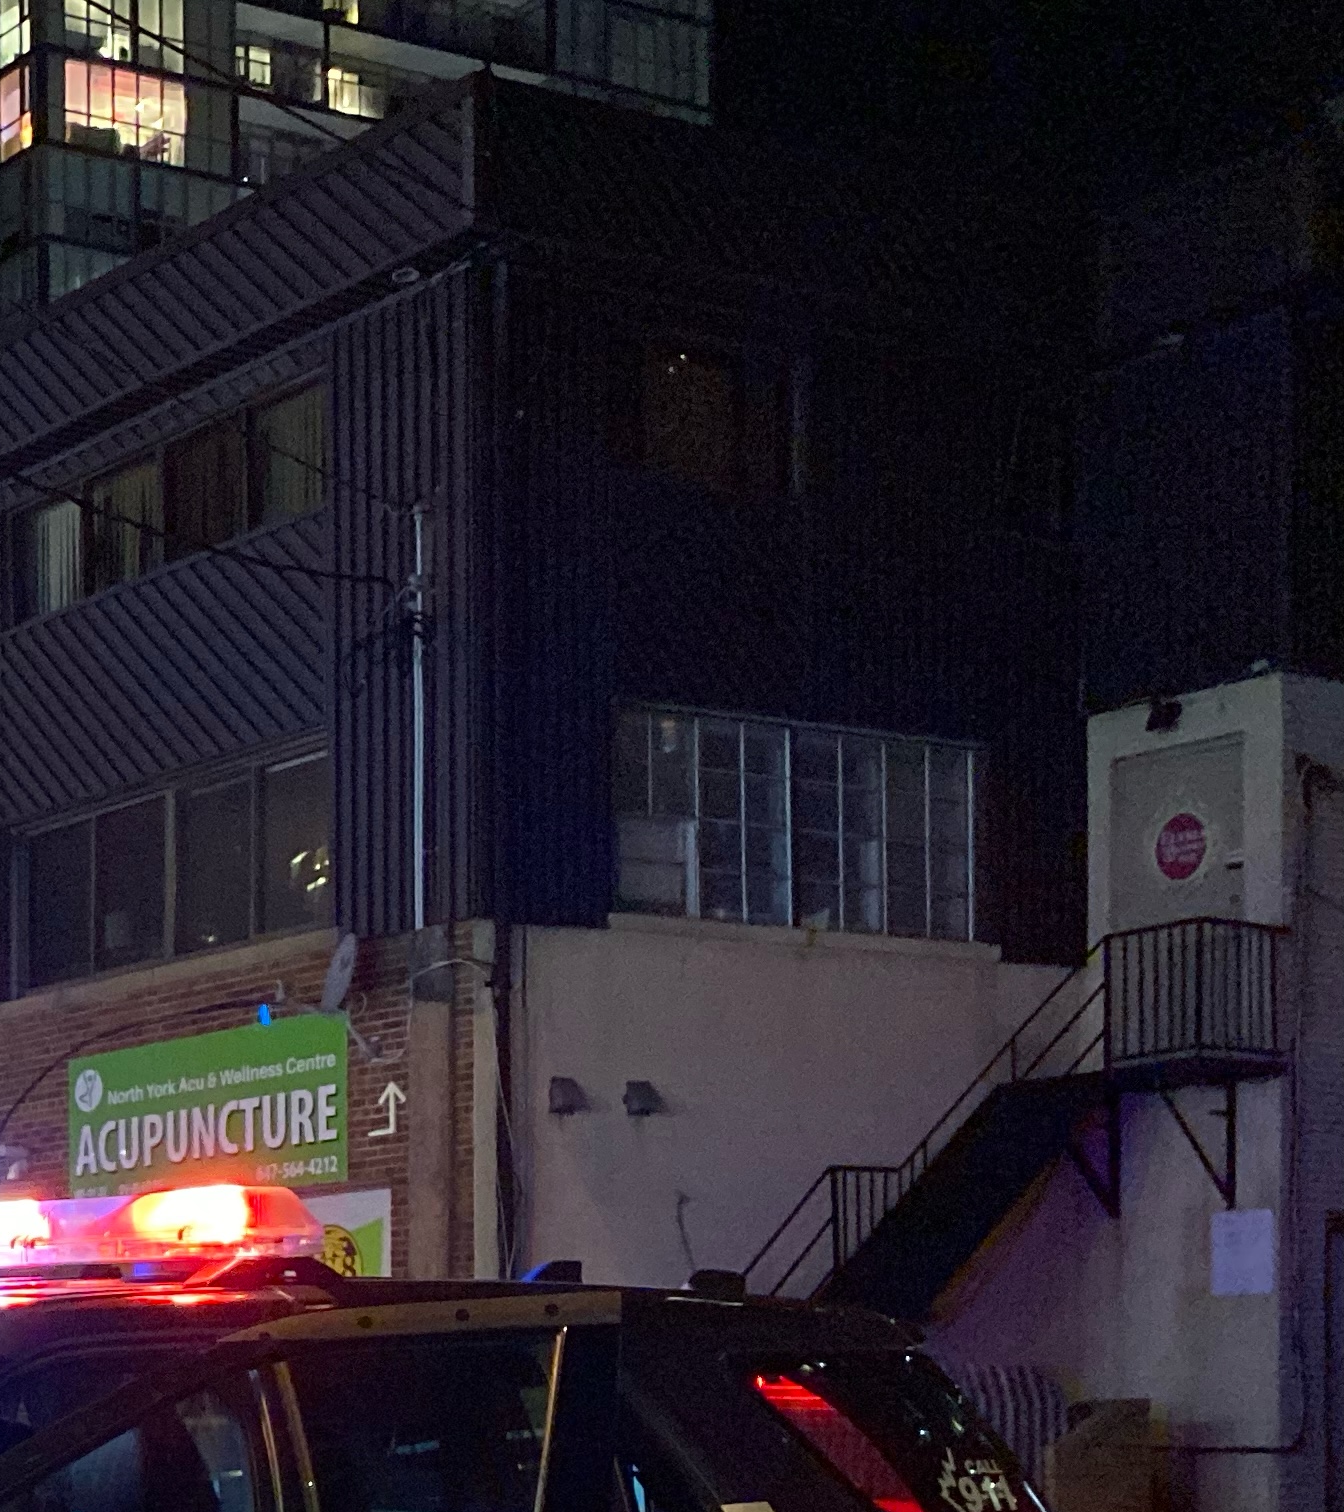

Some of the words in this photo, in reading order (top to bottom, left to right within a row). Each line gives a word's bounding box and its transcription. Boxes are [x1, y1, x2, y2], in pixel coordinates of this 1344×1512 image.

[107, 1084, 143, 1105] North
[146, 1079, 176, 1099] York
[178, 1077, 205, 1093] Acu
[207, 1072, 217, 1088] &
[220, 1063, 282, 1086] Wellness
[286, 1053, 337, 1075] Centre
[75, 1084, 338, 1176] ACUPUNCTURE
[963, 1458, 1003, 1475] CALL
